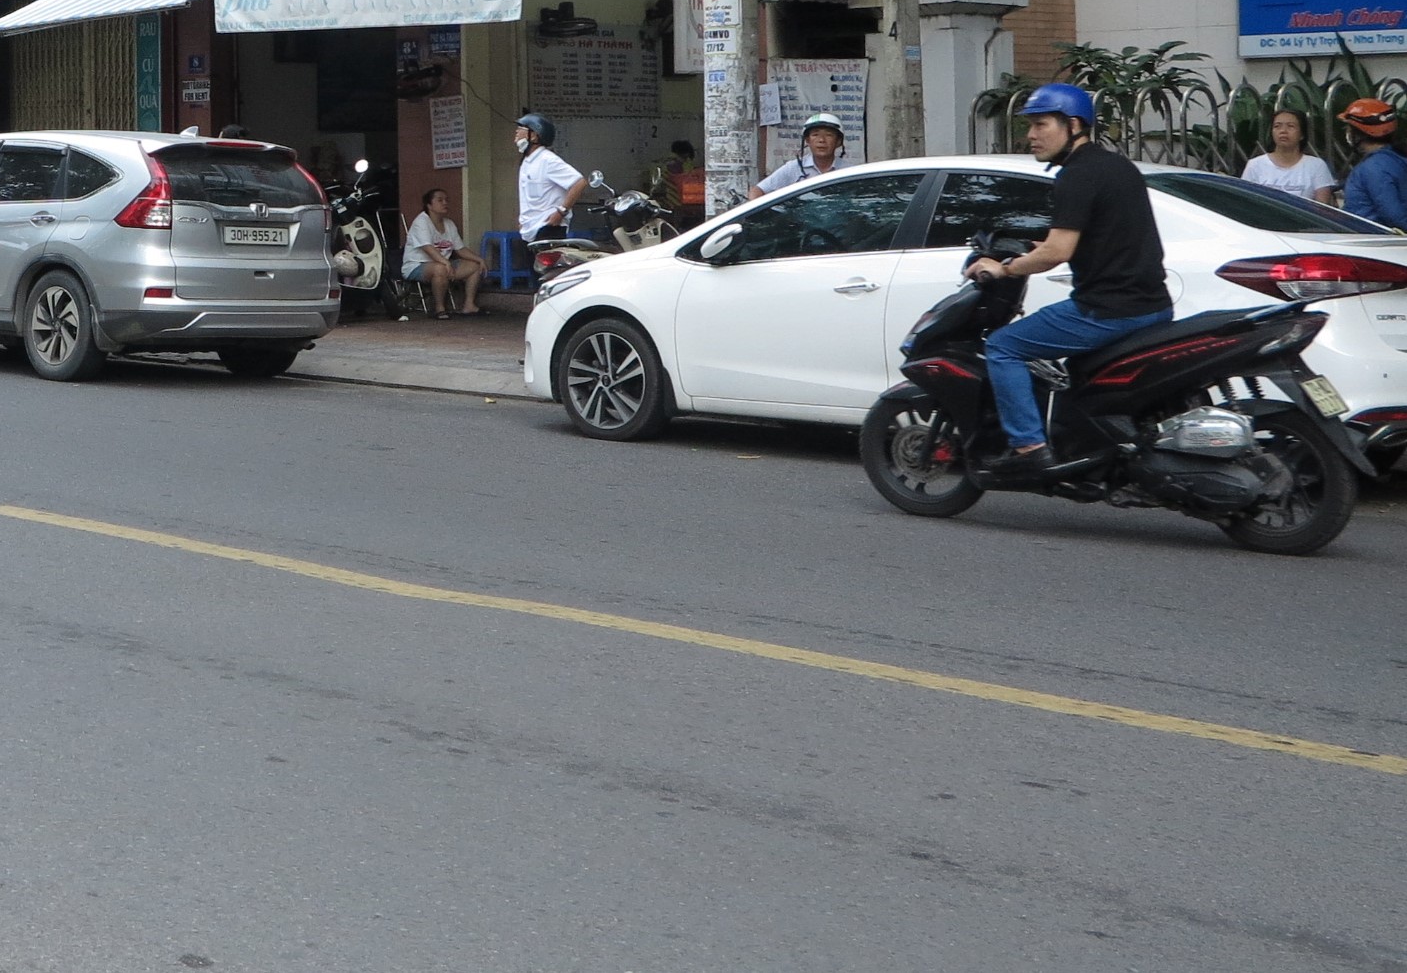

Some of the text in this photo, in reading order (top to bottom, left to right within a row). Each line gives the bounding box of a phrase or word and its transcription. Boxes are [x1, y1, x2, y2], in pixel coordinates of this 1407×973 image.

[1289, 6, 1404, 28] Nhanh Chóng
[1280, 37, 1291, 47] 04
[1294, 36, 1304, 48] Lý
[1319, 35, 1344, 48] Trọn
[1353, 34, 1374, 44] Nha
[1376, 33, 1404, 45] Trang
